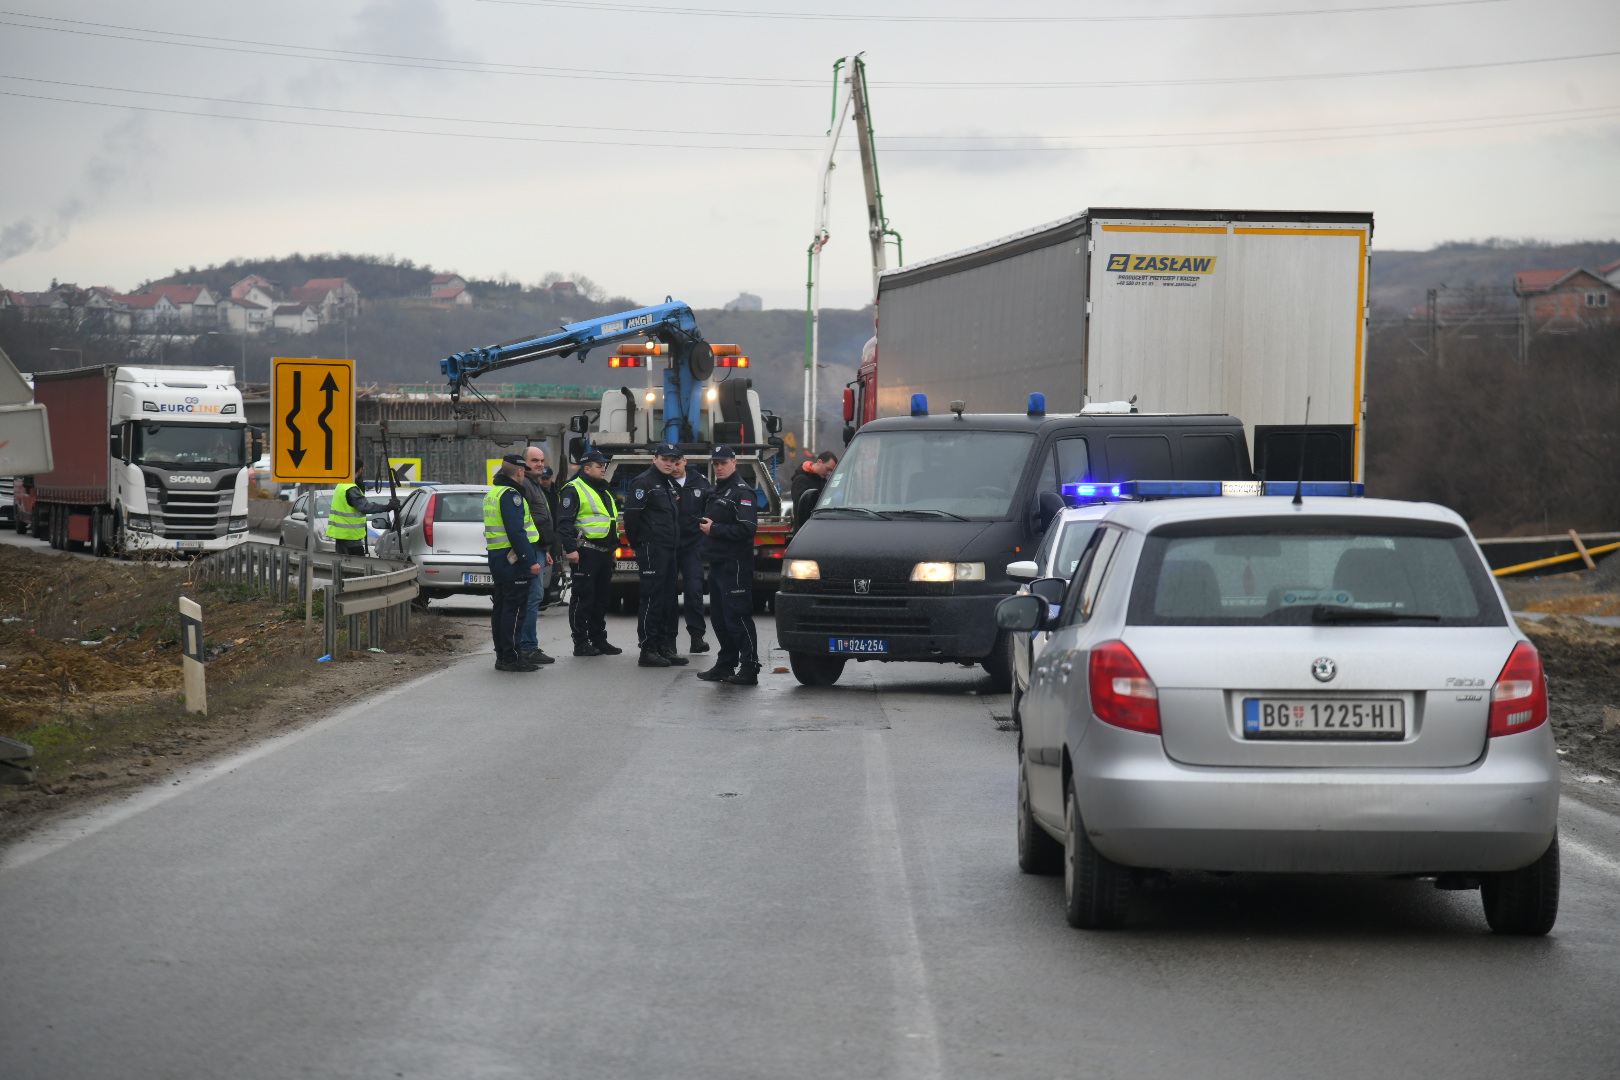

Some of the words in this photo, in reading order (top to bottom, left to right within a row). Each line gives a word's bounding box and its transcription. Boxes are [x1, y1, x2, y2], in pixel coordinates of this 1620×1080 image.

[1133, 256, 1212, 272] ZASŁAW
[160, 404, 221, 414] EUROLINE
[169, 475, 212, 484] SCANIA
[469, 574, 478, 583] BG
[1263, 704, 1290, 727] BG
